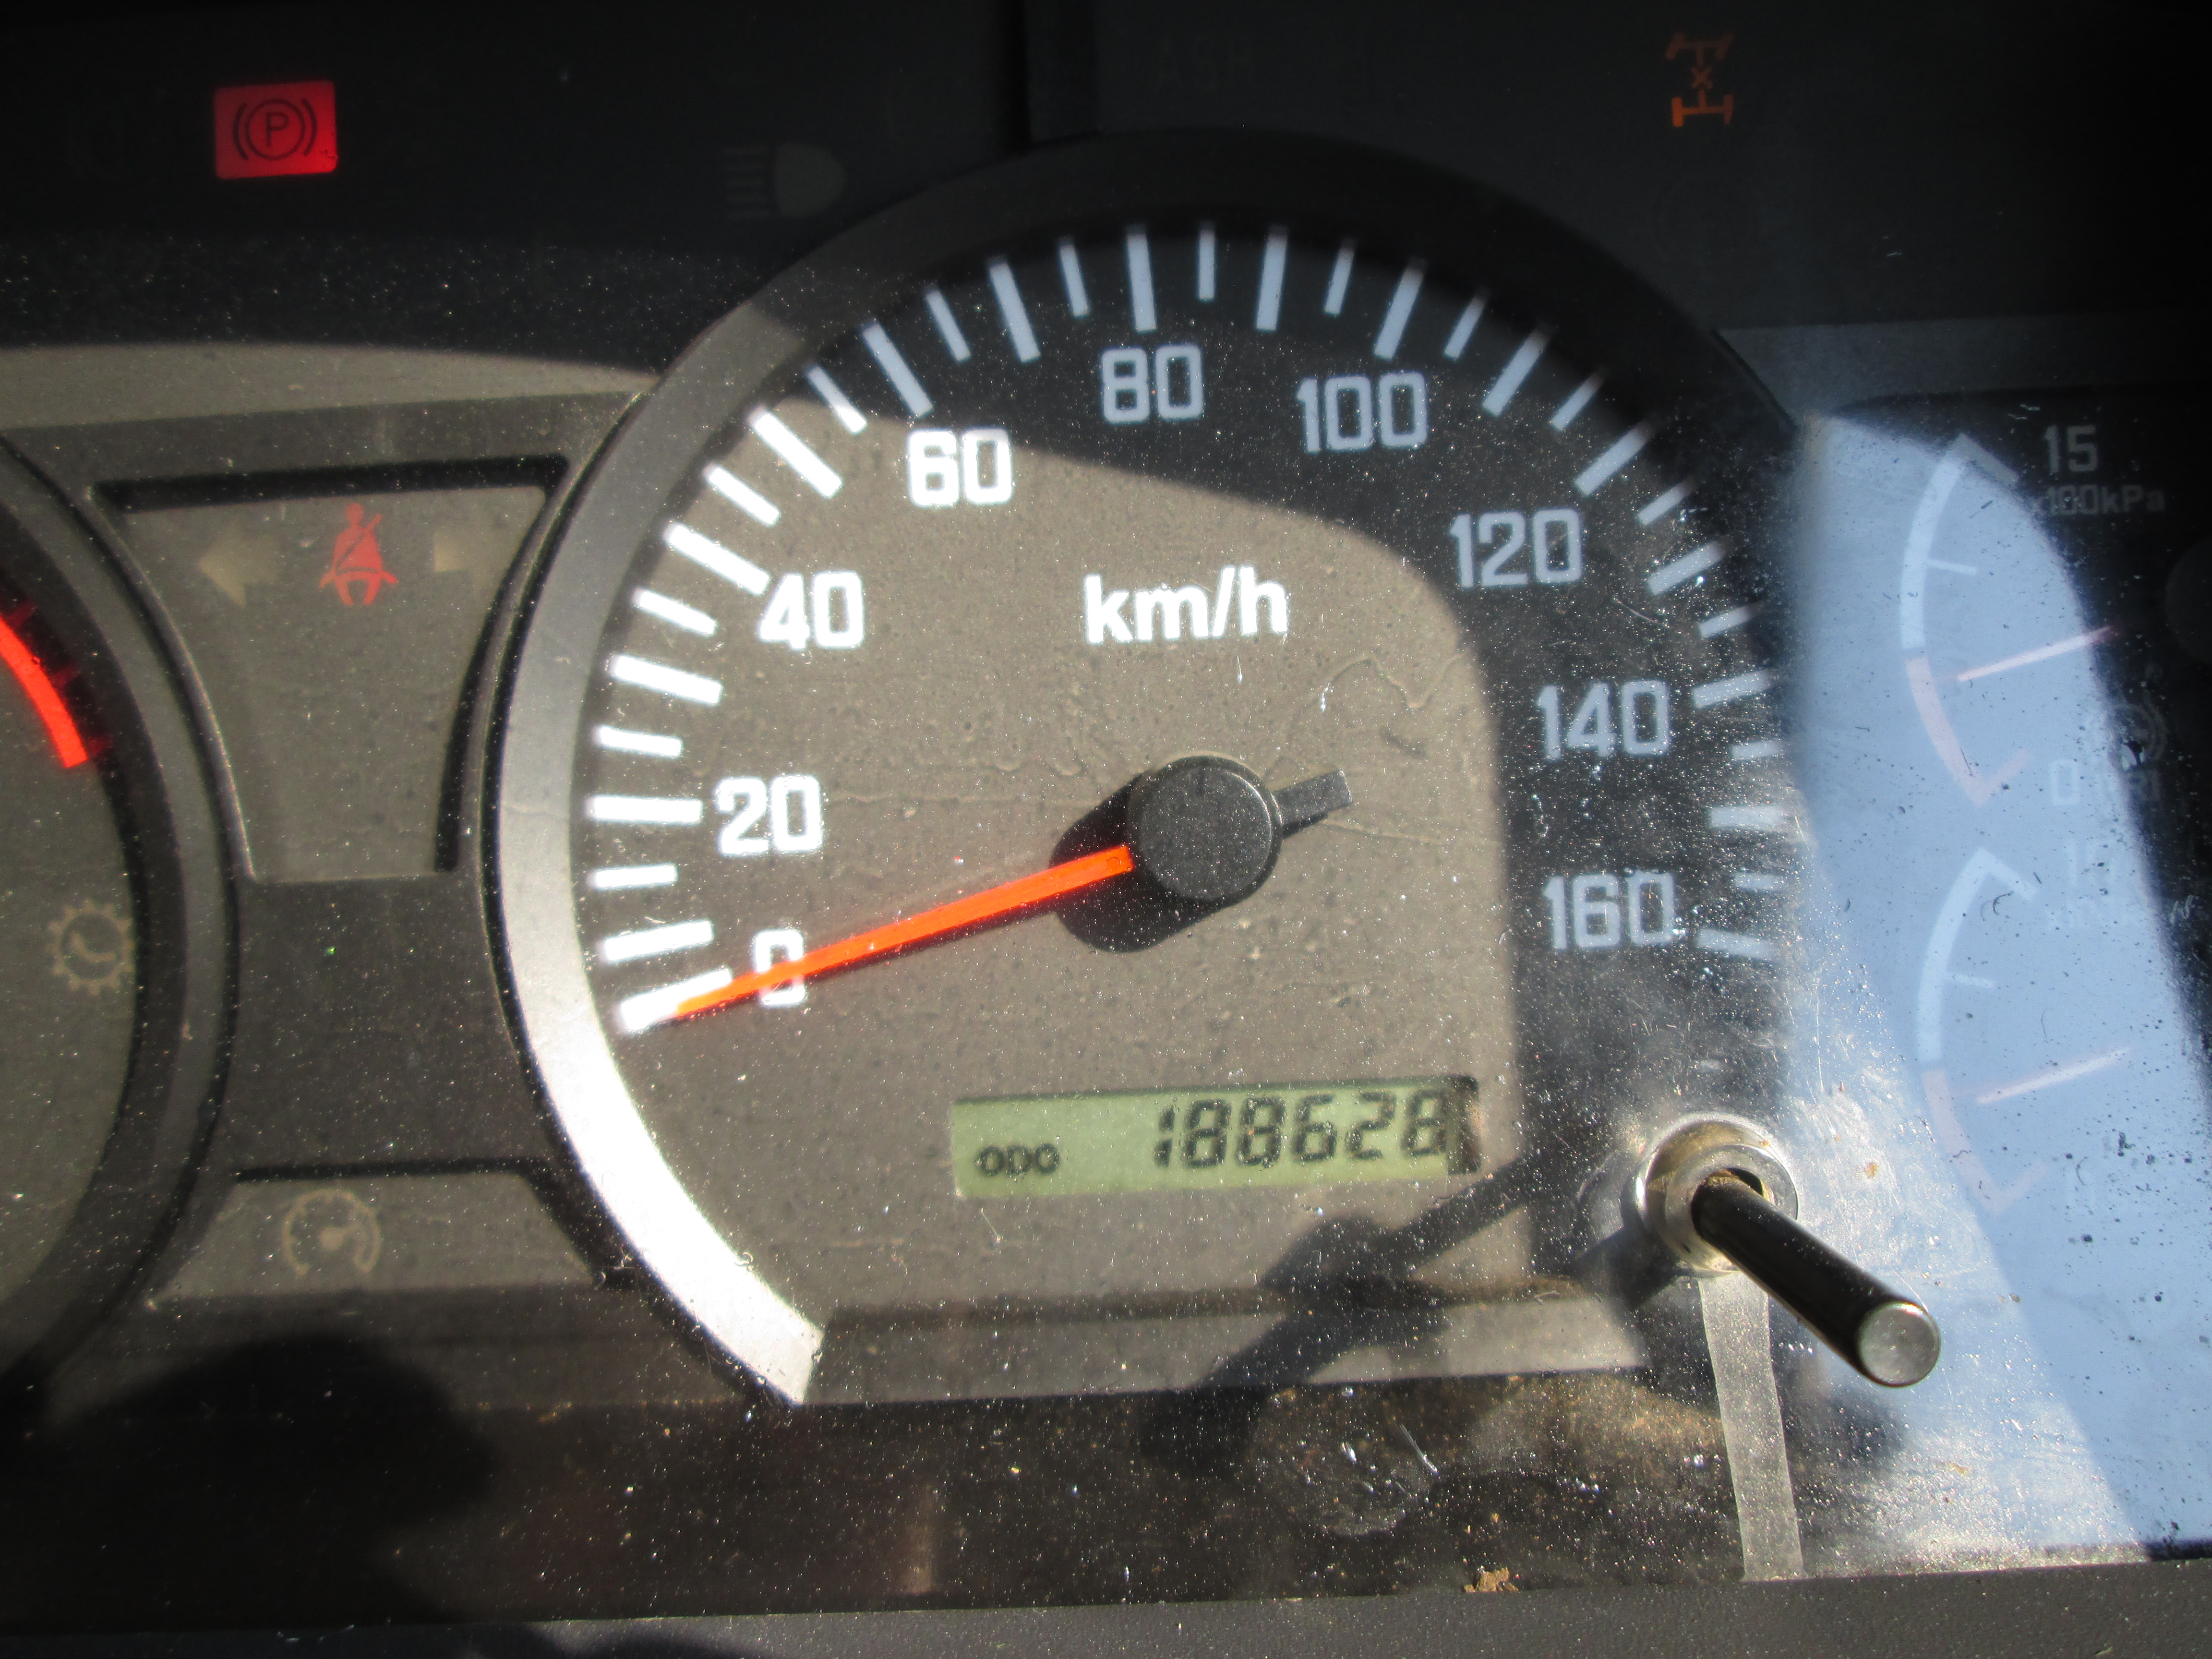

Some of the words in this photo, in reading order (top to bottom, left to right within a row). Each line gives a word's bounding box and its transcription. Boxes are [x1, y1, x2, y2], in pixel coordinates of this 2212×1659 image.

[266, 112, 289, 147] P
[1101, 345, 1203, 424] 80
[1296, 372, 1429, 453] 100
[906, 428, 1014, 506] 60
[2044, 424, 2098, 475] 15
[1451, 508, 1584, 588] 120
[757, 570, 866, 649] 40
[1083, 565, 1290, 644] km/h
[1537, 679, 1670, 759] 140
[715, 776, 823, 854] 20
[1543, 870, 1675, 950] 160
[754, 930, 807, 1007] 0
[1154, 1090, 1447, 1168] 188628
